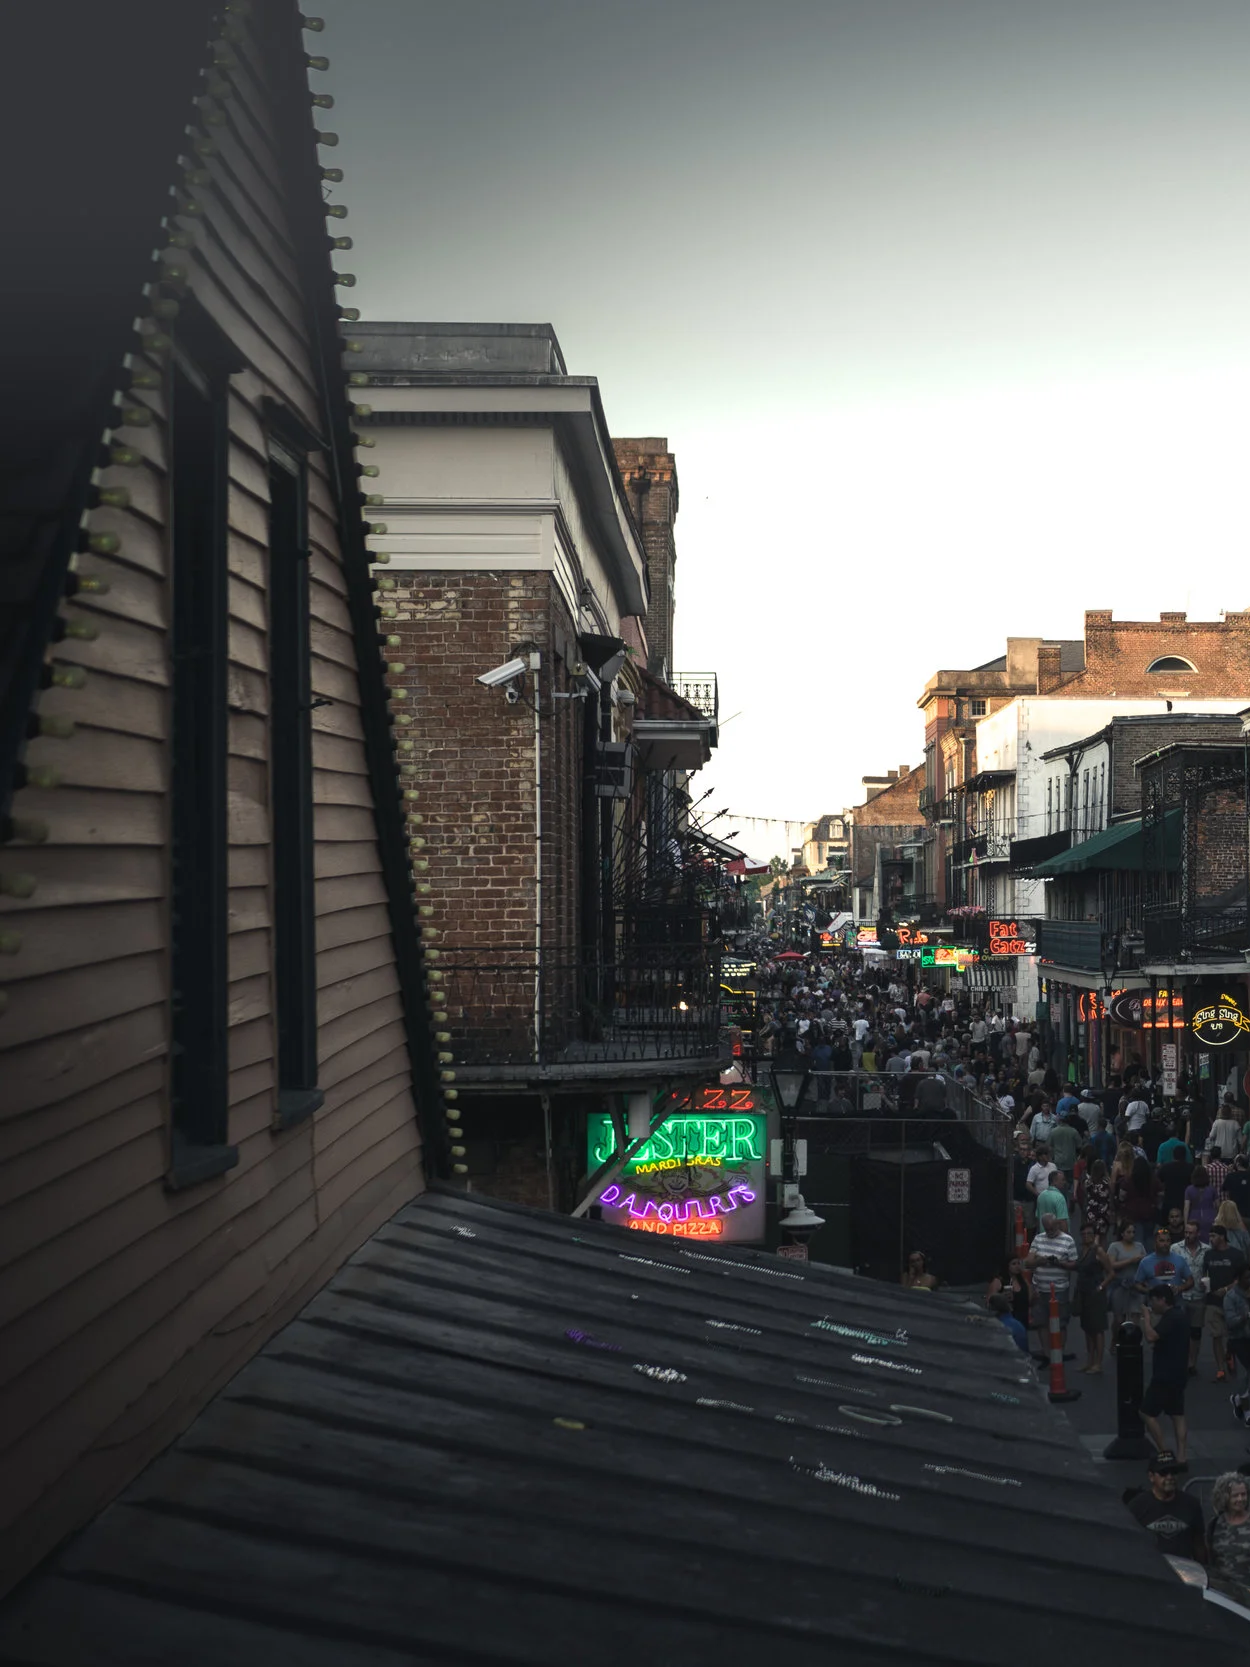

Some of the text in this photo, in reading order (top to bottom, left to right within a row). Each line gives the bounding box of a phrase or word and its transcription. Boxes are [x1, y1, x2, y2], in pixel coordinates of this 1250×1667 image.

[990, 921, 1018, 937] Fat
[990, 938, 1025, 953] Catz
[636, 1158, 681, 1174] MARDI
[629, 1222, 720, 1236] AND PIZZA
